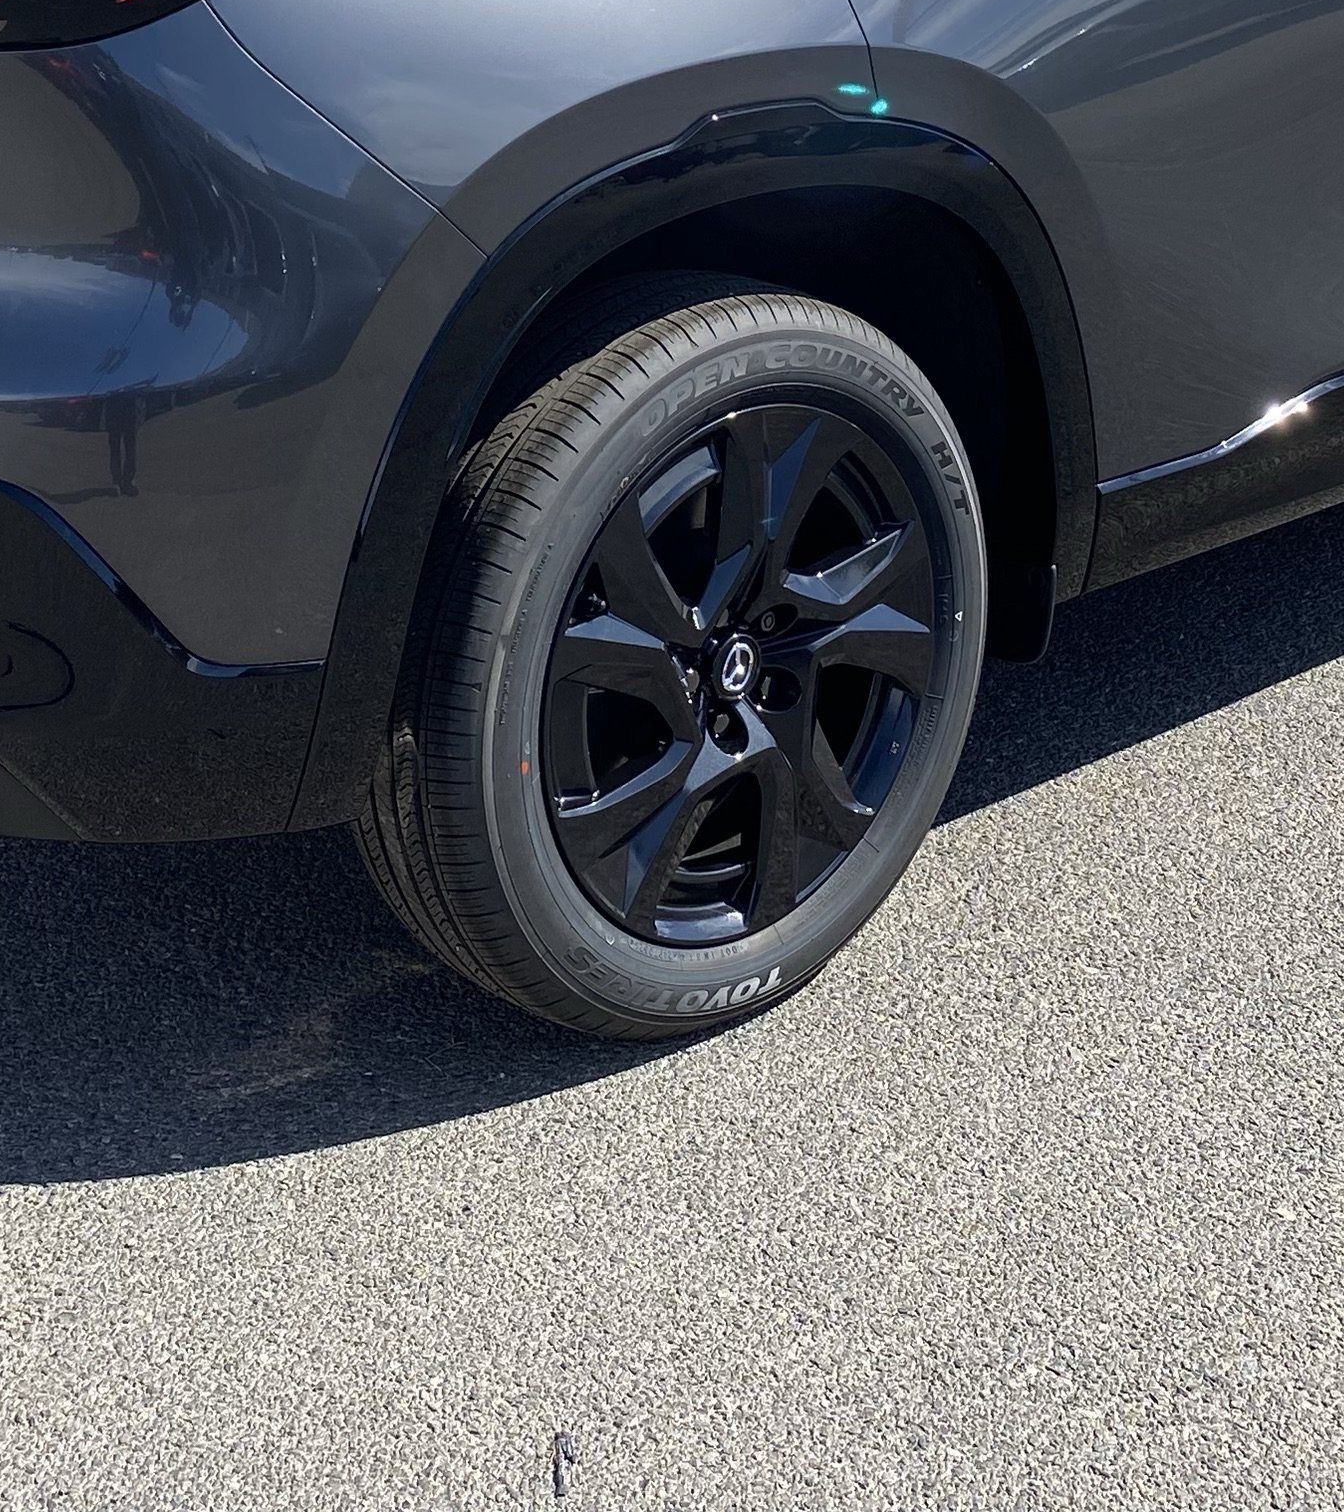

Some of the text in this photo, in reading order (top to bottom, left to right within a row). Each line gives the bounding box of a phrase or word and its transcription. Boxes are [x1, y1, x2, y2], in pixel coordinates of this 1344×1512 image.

[639, 343, 972, 516] OPEN COUNTRY H/T
[564, 946, 675, 1012] TIRES
[675, 965, 783, 1013] TOYO
